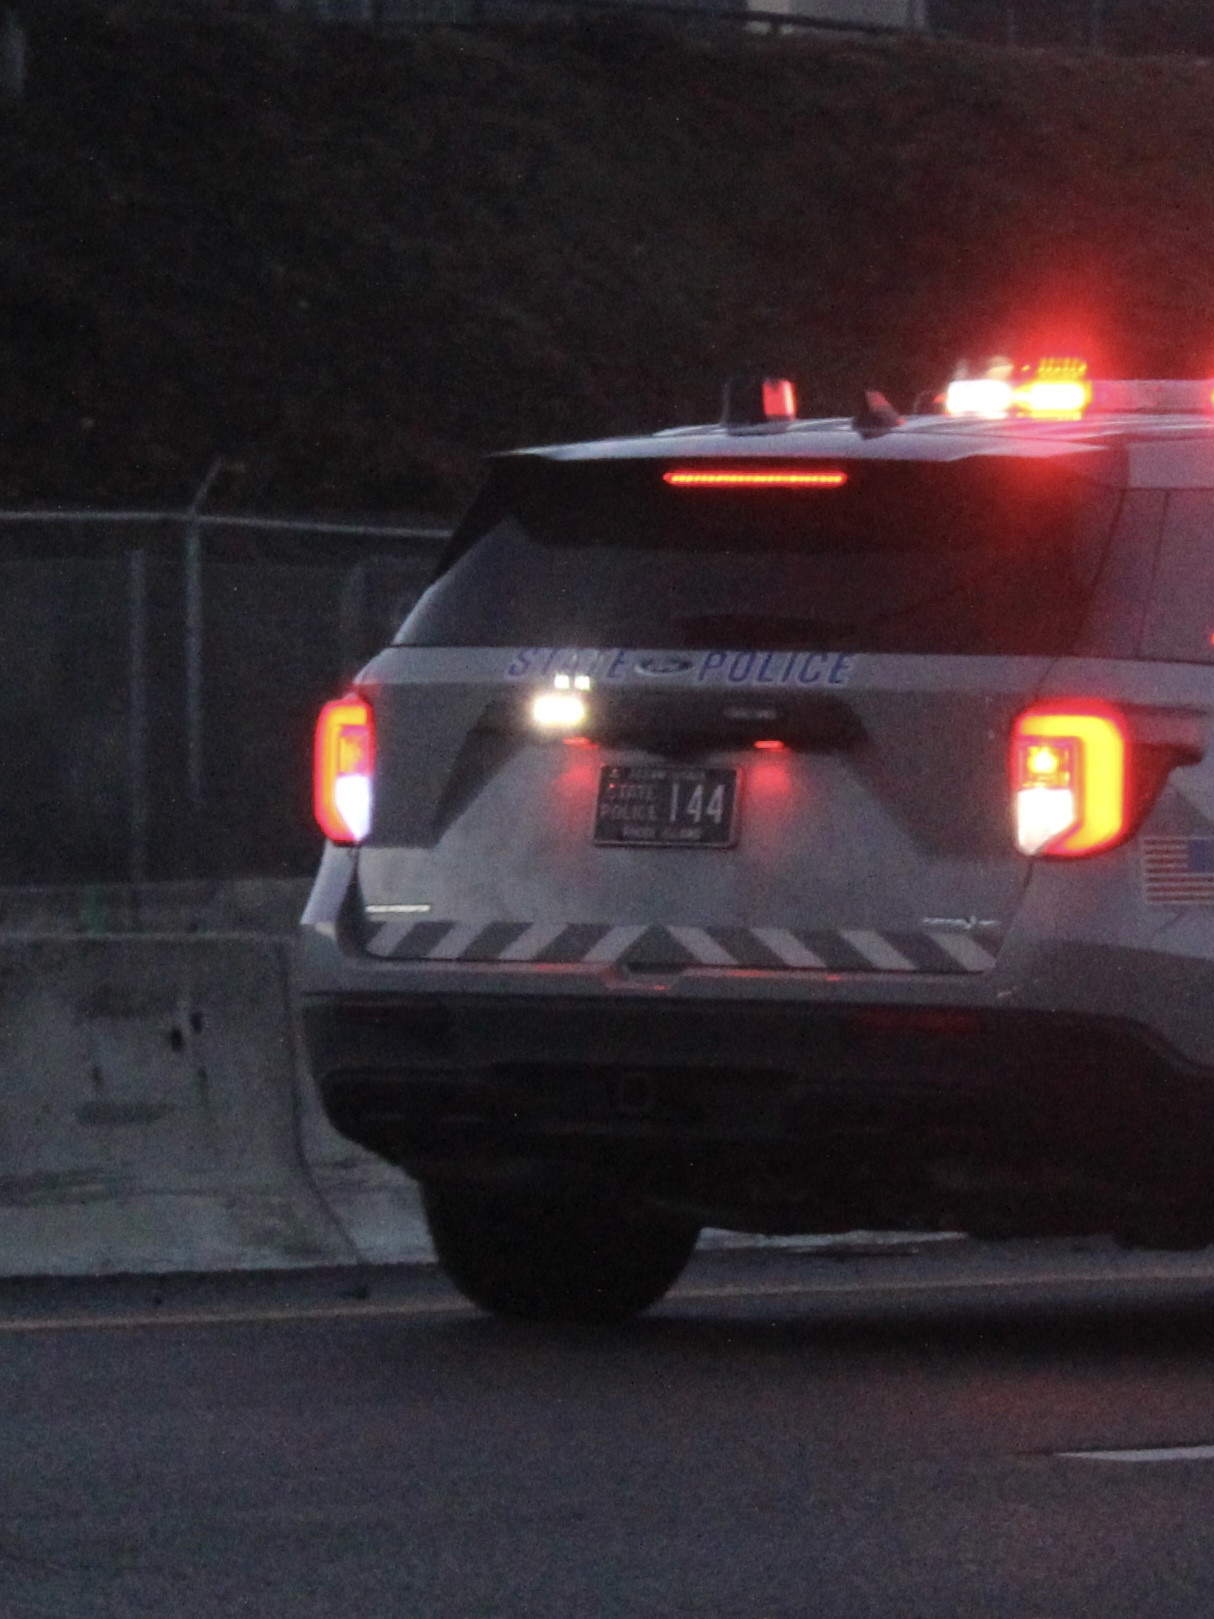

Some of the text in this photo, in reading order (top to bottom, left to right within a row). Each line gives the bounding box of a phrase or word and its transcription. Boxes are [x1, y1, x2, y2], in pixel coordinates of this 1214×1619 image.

[508, 649, 851, 684] STATE POLICE
[669, 783, 725, 824] 144
